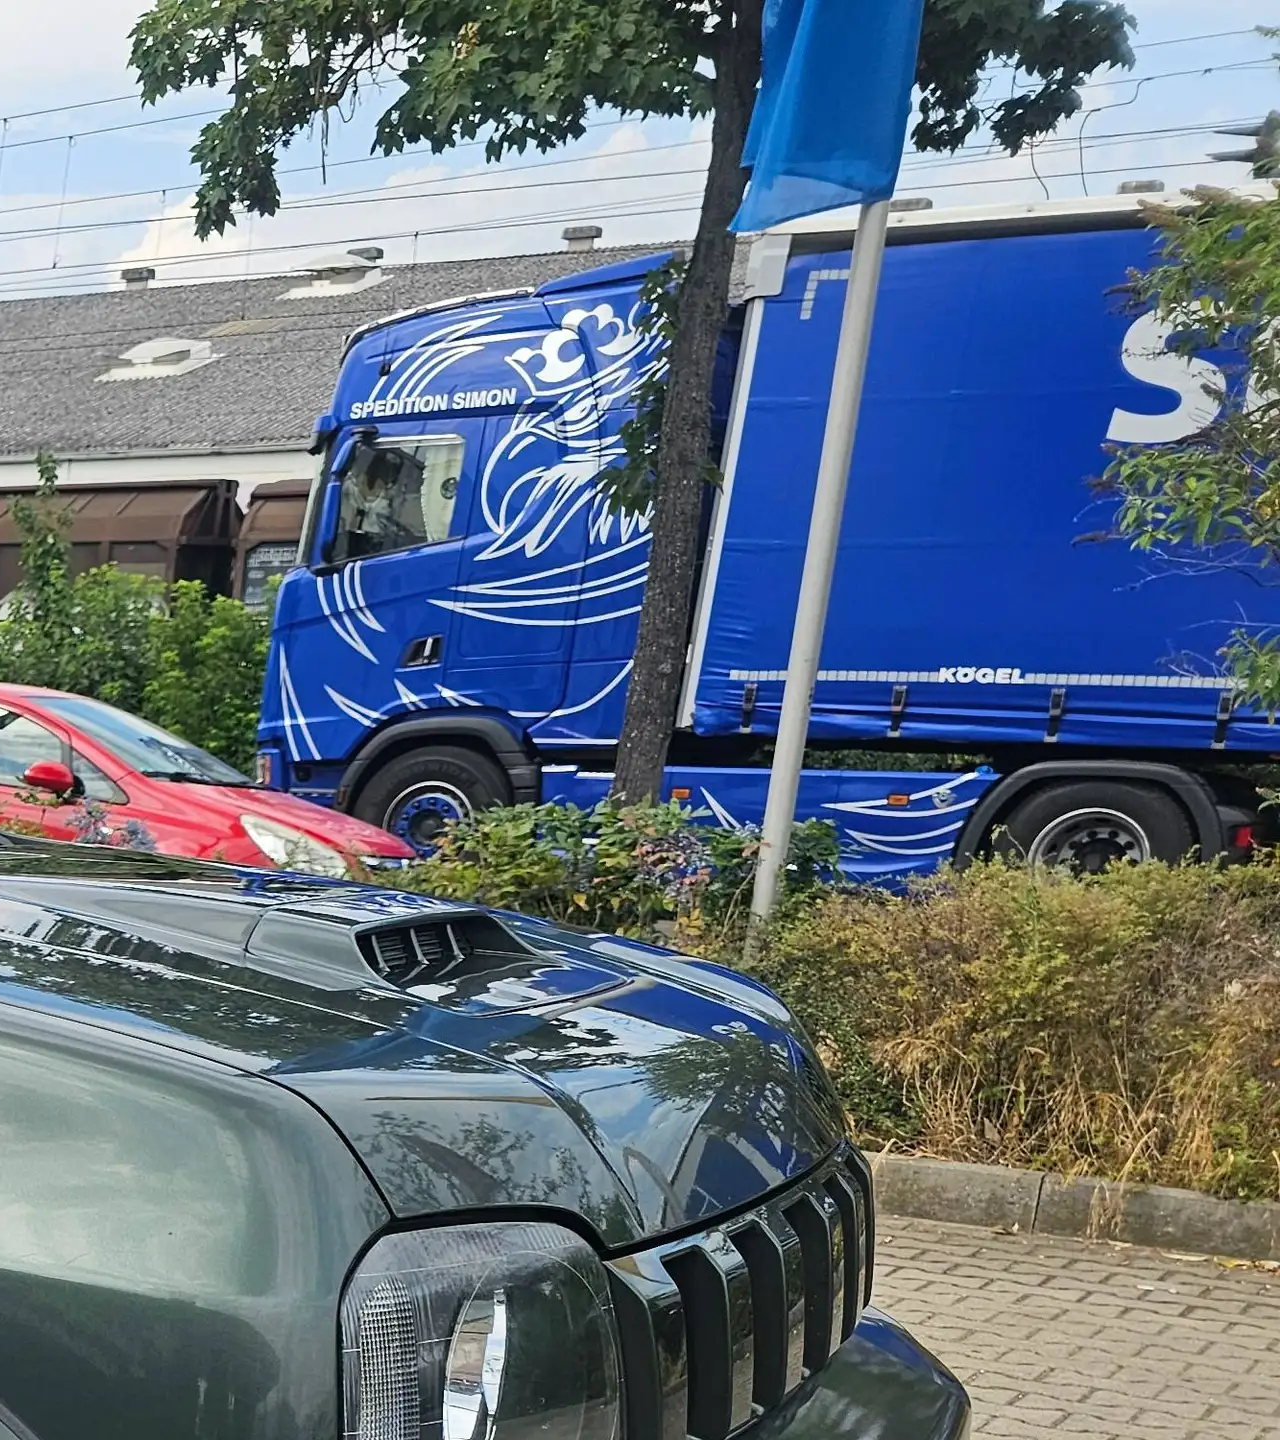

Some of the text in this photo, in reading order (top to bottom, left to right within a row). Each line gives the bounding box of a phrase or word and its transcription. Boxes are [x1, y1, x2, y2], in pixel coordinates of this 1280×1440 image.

[349, 387, 517, 420] SPEDITION SIMON
[938, 666, 1025, 684] KÖGEL
